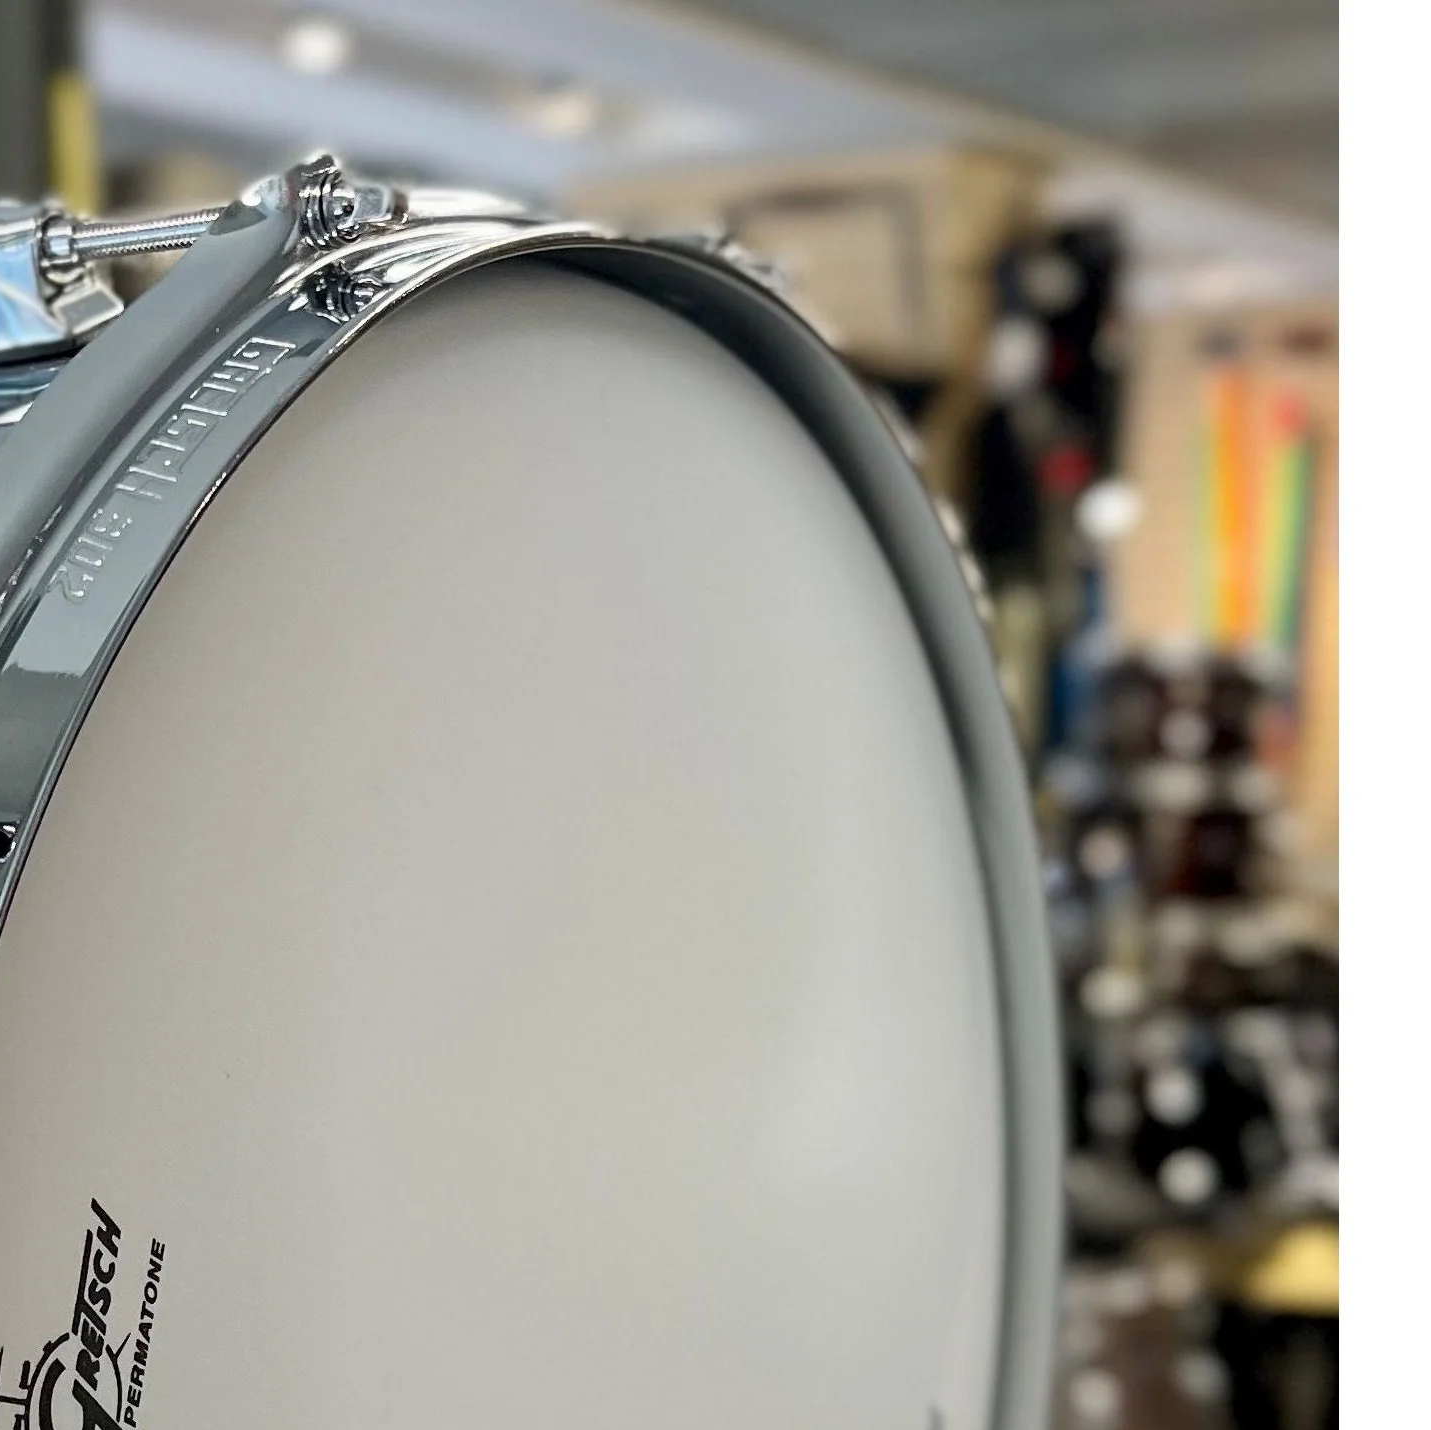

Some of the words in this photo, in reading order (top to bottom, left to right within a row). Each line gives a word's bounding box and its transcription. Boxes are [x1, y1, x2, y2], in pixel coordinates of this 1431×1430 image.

[115, 336, 297, 500] GRETSCH
[45, 508, 133, 602] 302
[123, 1237, 167, 1428] PERMATONE
